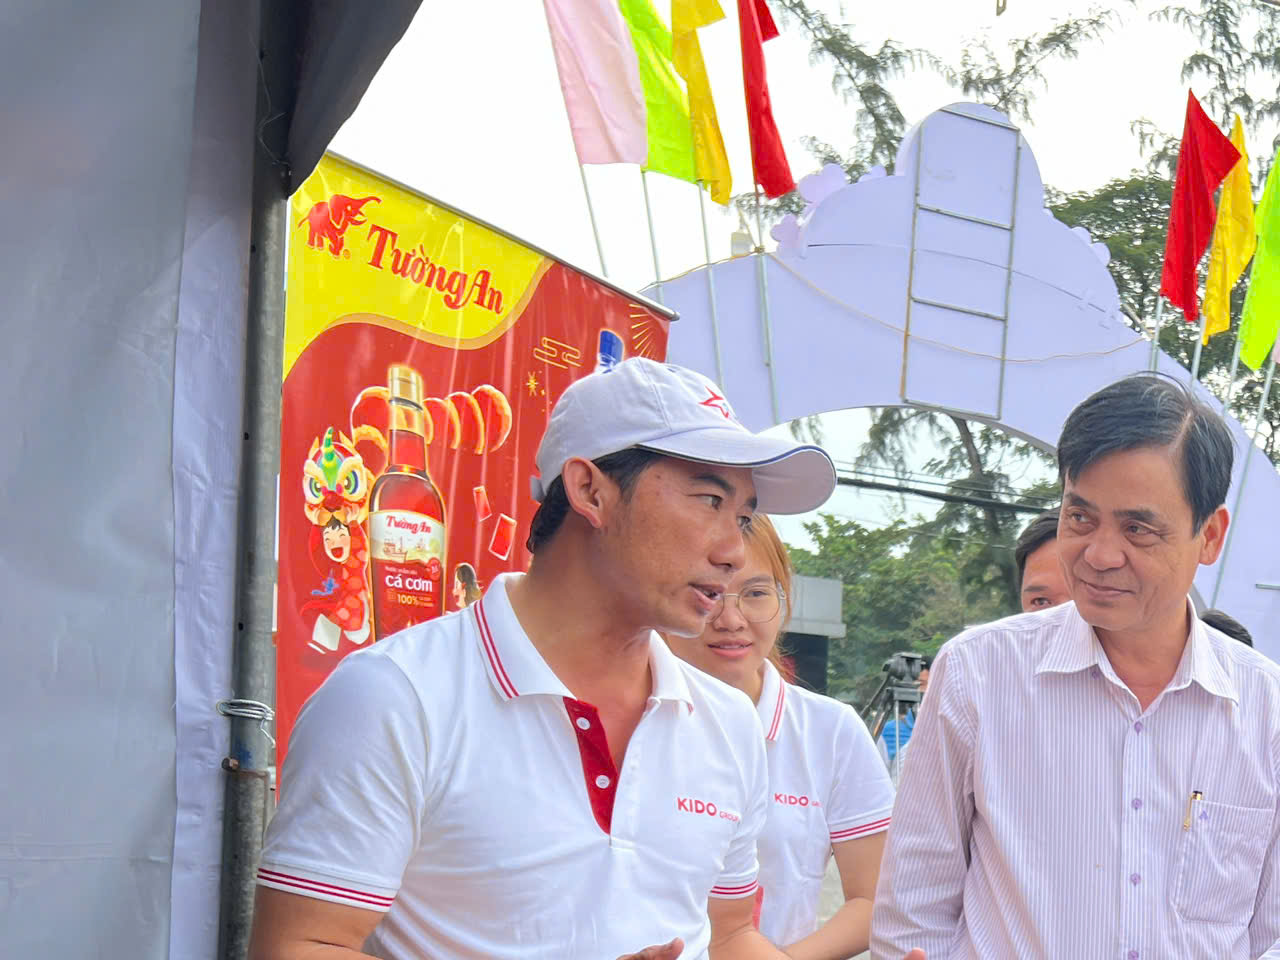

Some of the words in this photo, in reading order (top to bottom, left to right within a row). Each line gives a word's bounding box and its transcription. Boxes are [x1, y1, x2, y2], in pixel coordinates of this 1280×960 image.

[385, 574, 403, 588] cá
[405, 577, 433, 592] cơm
[677, 797, 717, 816] KIDO
[774, 793, 809, 807] KIDO
